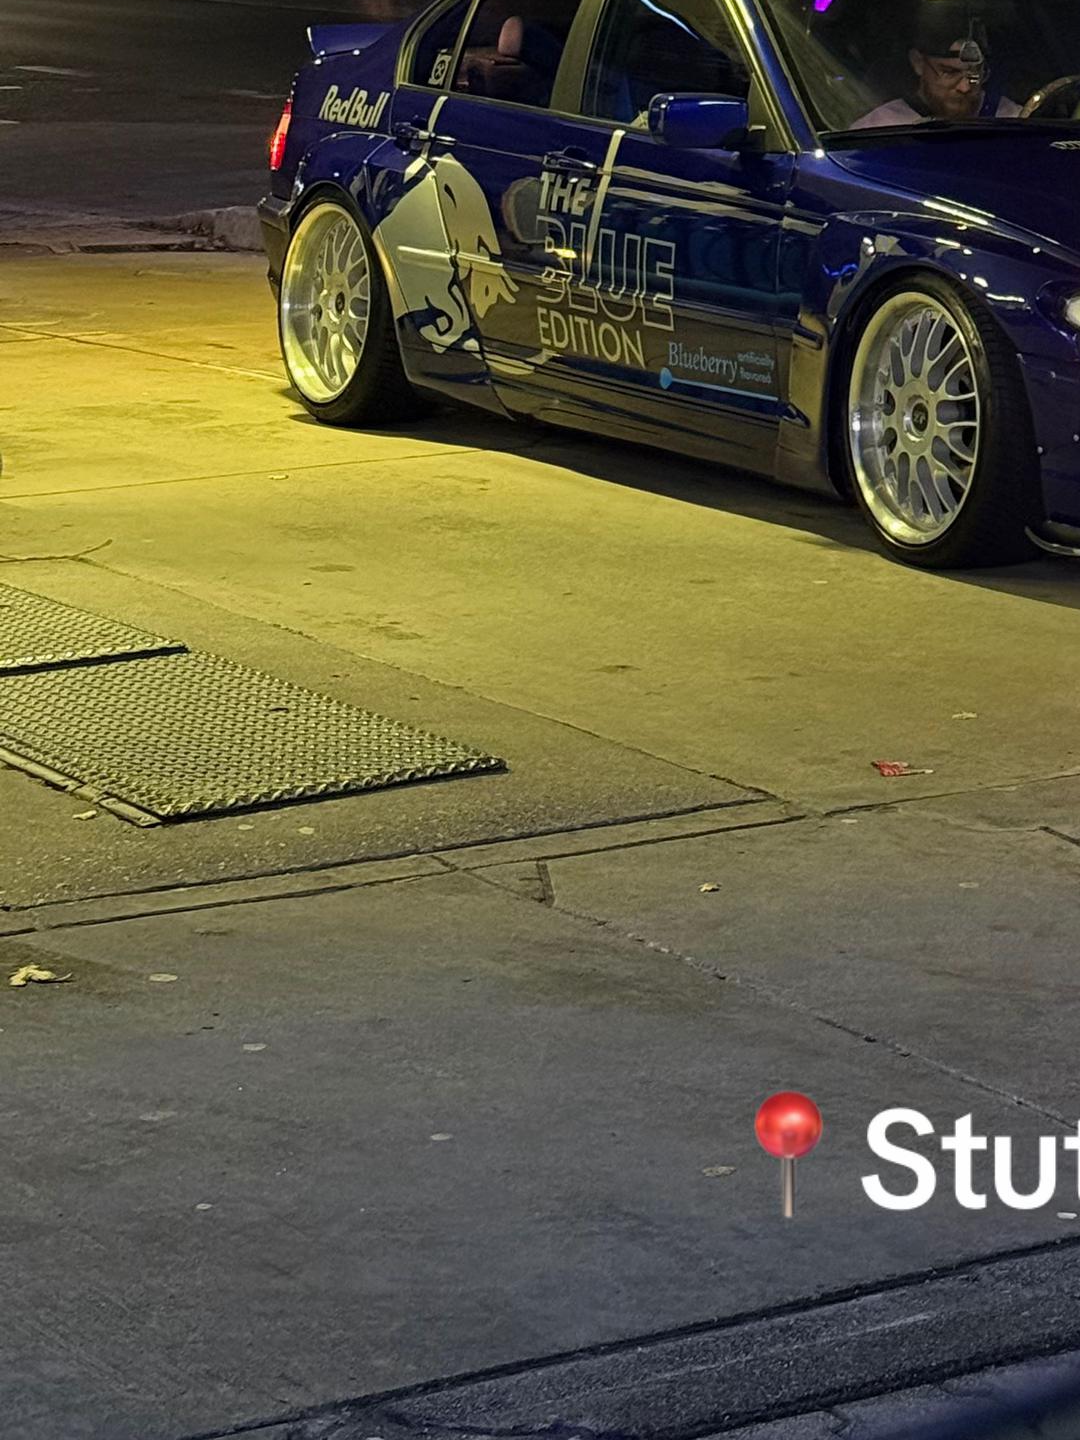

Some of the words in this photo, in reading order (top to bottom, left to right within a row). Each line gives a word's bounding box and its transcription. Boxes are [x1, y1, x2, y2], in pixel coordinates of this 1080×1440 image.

[539, 171, 592, 216] THE
[536, 216, 676, 332] BLUE
[537, 307, 647, 370] EDITION
[668, 341, 739, 384] Blueberry
